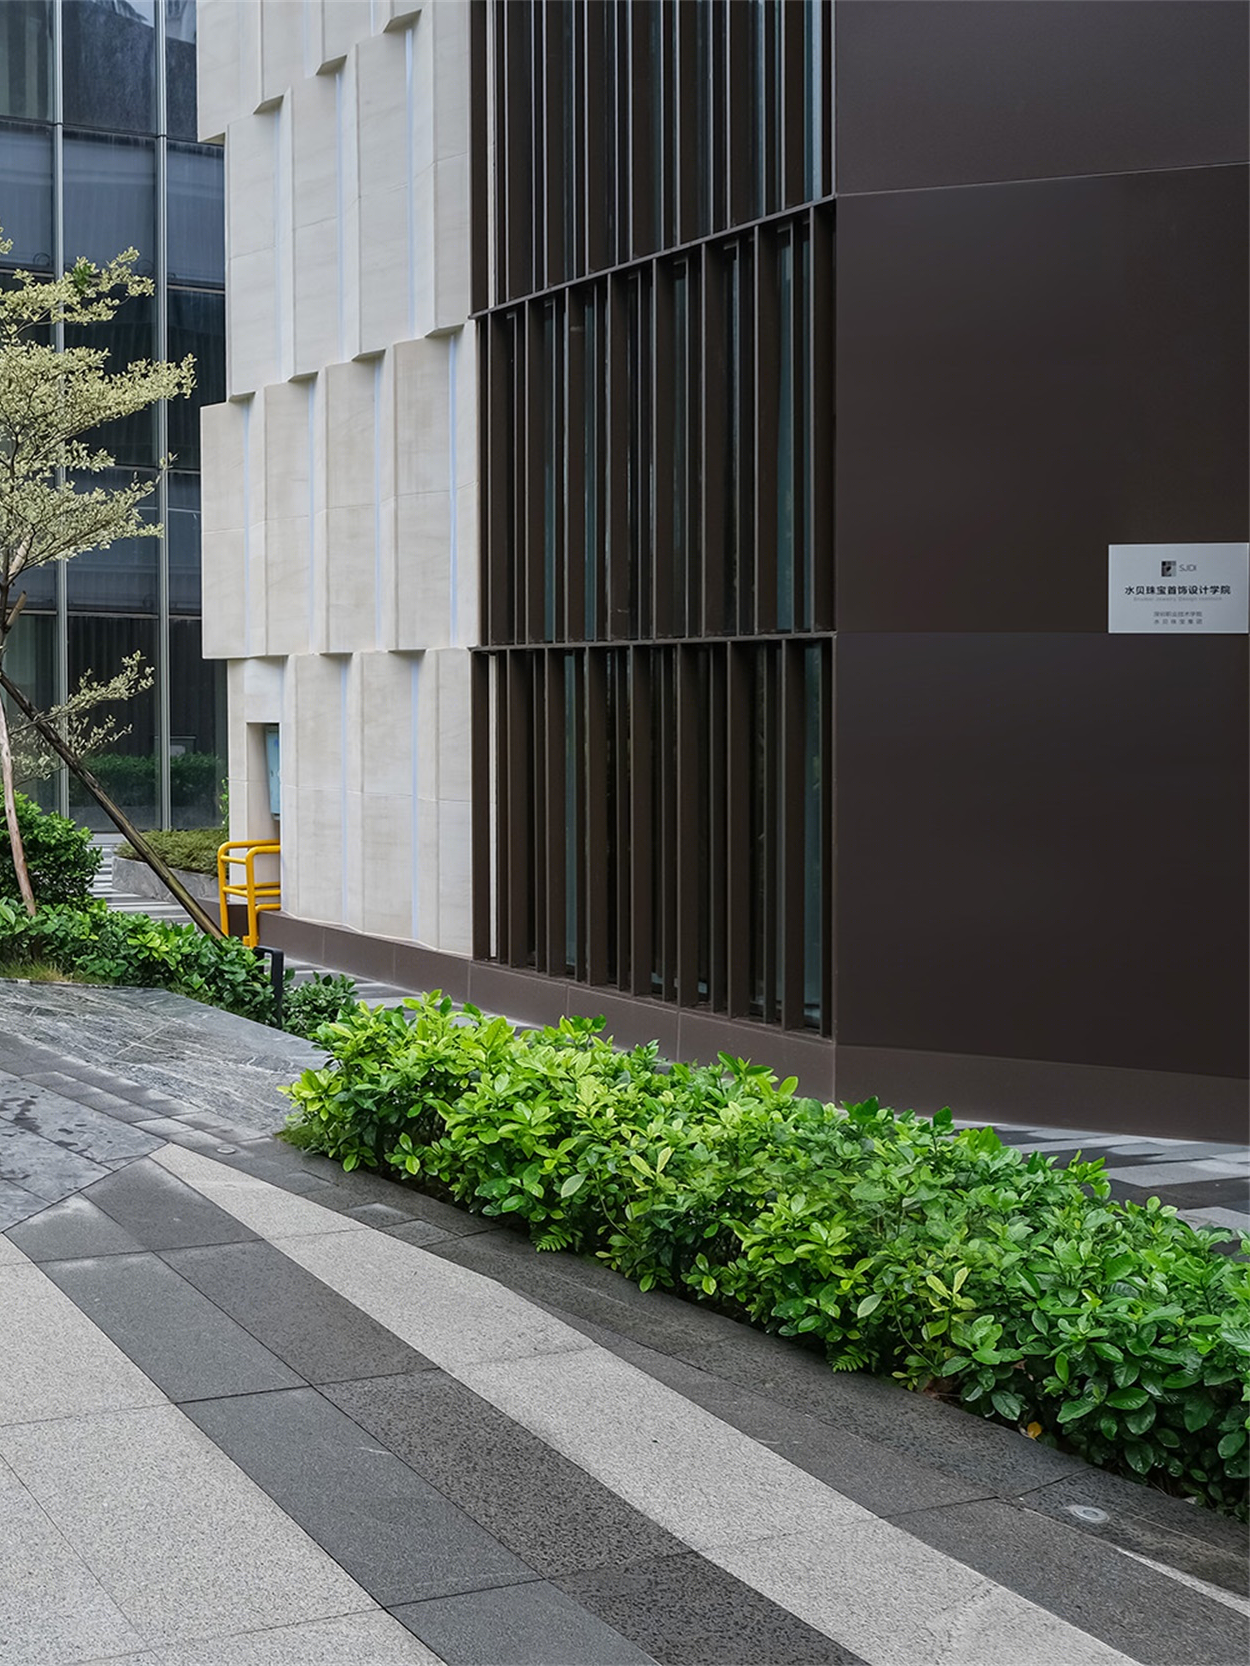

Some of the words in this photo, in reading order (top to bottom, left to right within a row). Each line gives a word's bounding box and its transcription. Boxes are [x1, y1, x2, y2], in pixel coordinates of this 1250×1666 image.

[1125, 585, 1232, 595] 水贝珠宝首饰设计学院
